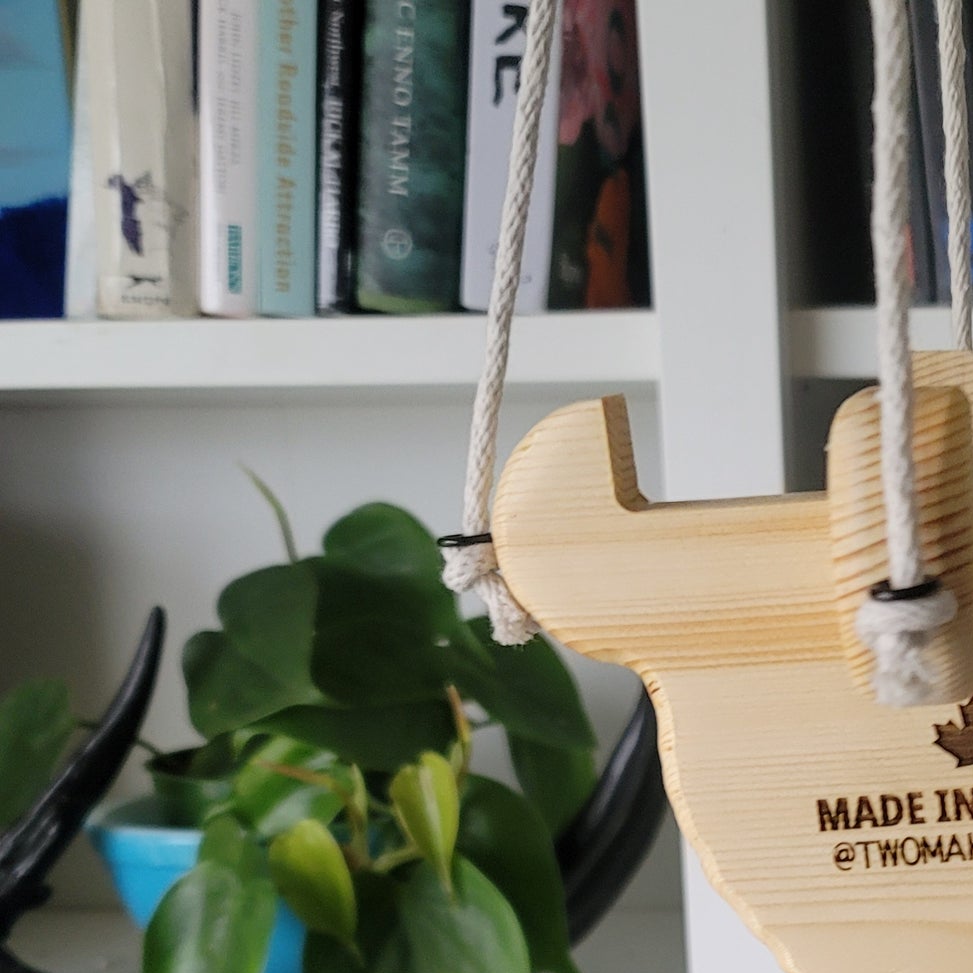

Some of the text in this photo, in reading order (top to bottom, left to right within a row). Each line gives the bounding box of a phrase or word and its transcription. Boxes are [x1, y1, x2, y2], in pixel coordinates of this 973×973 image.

[391, 27, 415, 107] ENNO
[388, 116, 412, 197] TAMM
[274, 176, 296, 293] Attraction
[816, 790, 926, 832] MADE
